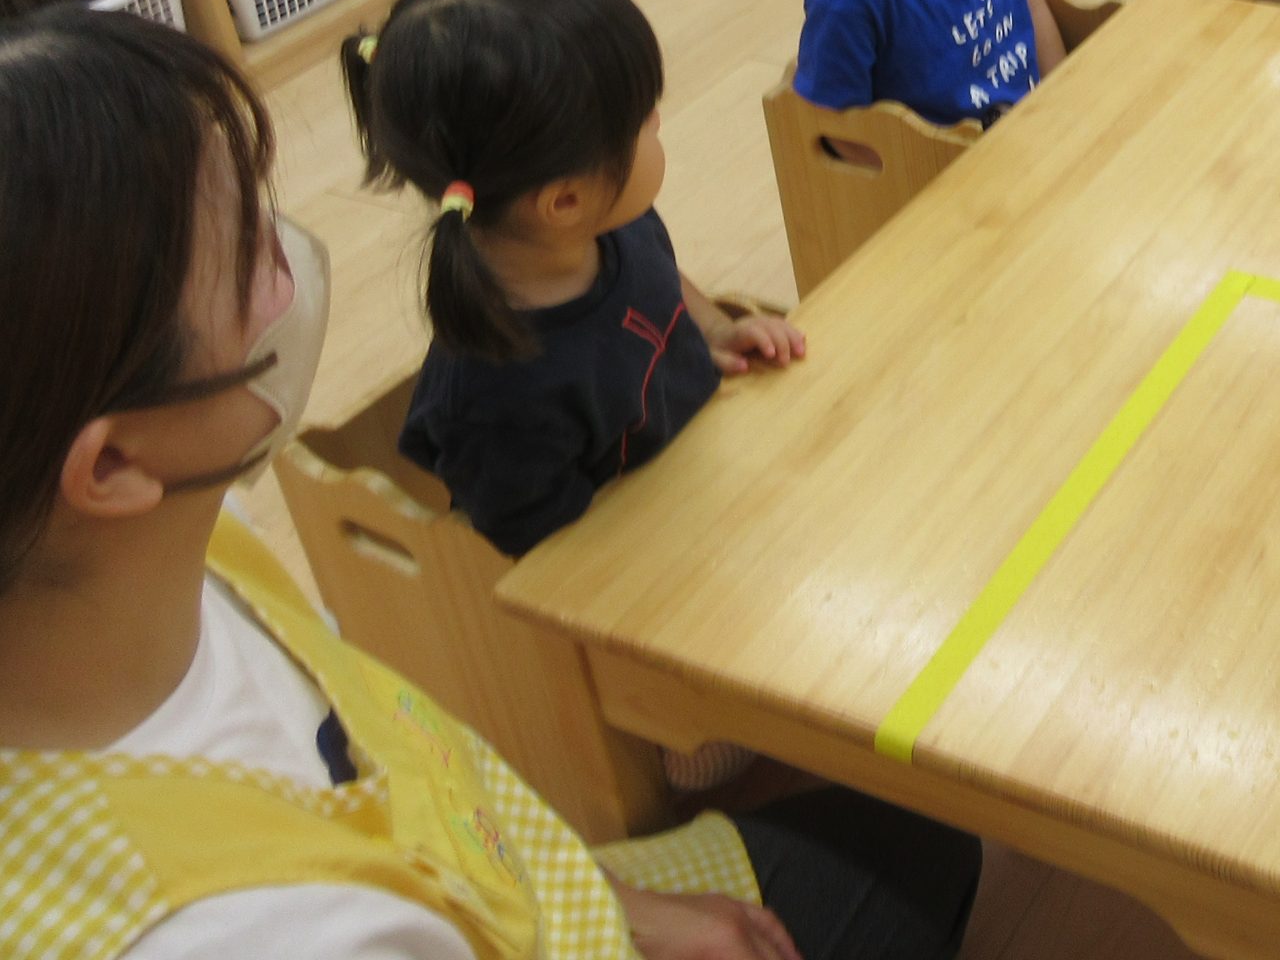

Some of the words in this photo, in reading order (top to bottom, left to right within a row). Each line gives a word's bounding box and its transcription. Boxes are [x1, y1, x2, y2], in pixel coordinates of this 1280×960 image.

[995, 11, 1013, 43] ON
[970, 84, 990, 109] A
[986, 42, 1027, 89] TRIP
